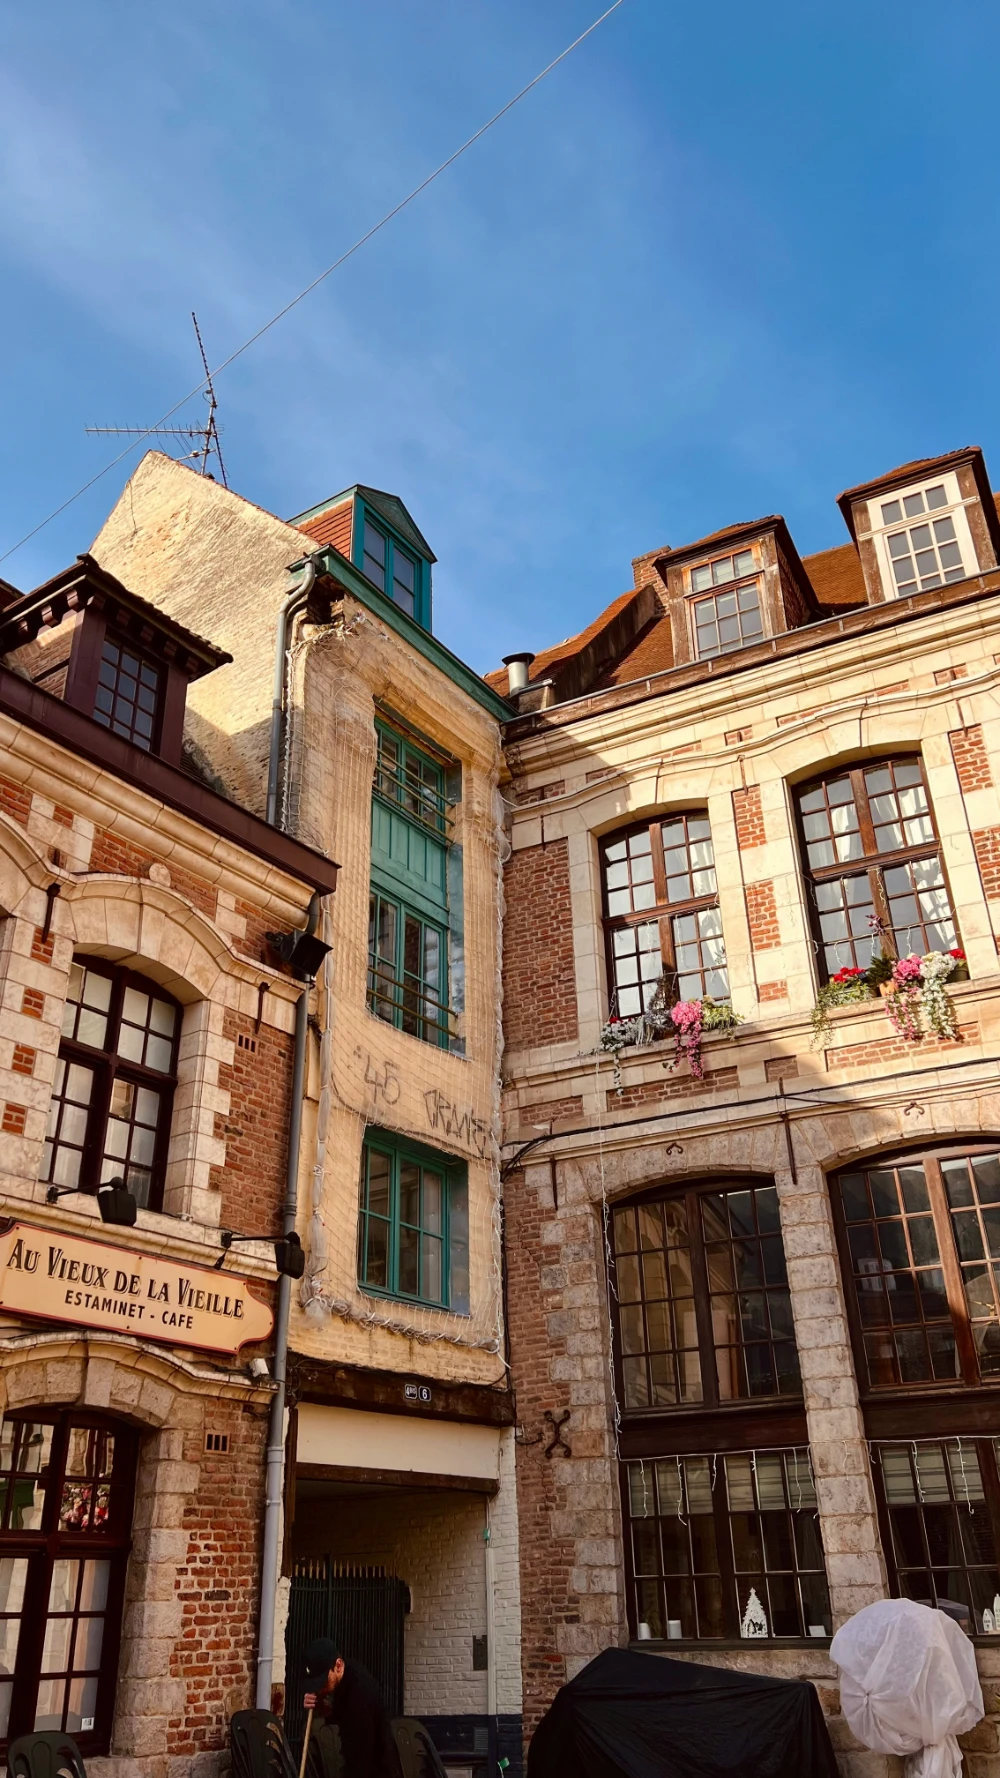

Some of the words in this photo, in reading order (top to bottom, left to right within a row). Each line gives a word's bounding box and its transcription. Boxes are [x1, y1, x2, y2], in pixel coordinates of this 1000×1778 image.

[47, 1246, 110, 1291] VIEUX
[113, 1270, 141, 1297] DE
[147, 1278, 169, 1305] LA
[177, 1277, 244, 1320] VIEILLE
[64, 1289, 146, 1319] ESTAMINET
[161, 1310, 194, 1330] CAFE
[422, 1388, 428, 1400] 6
